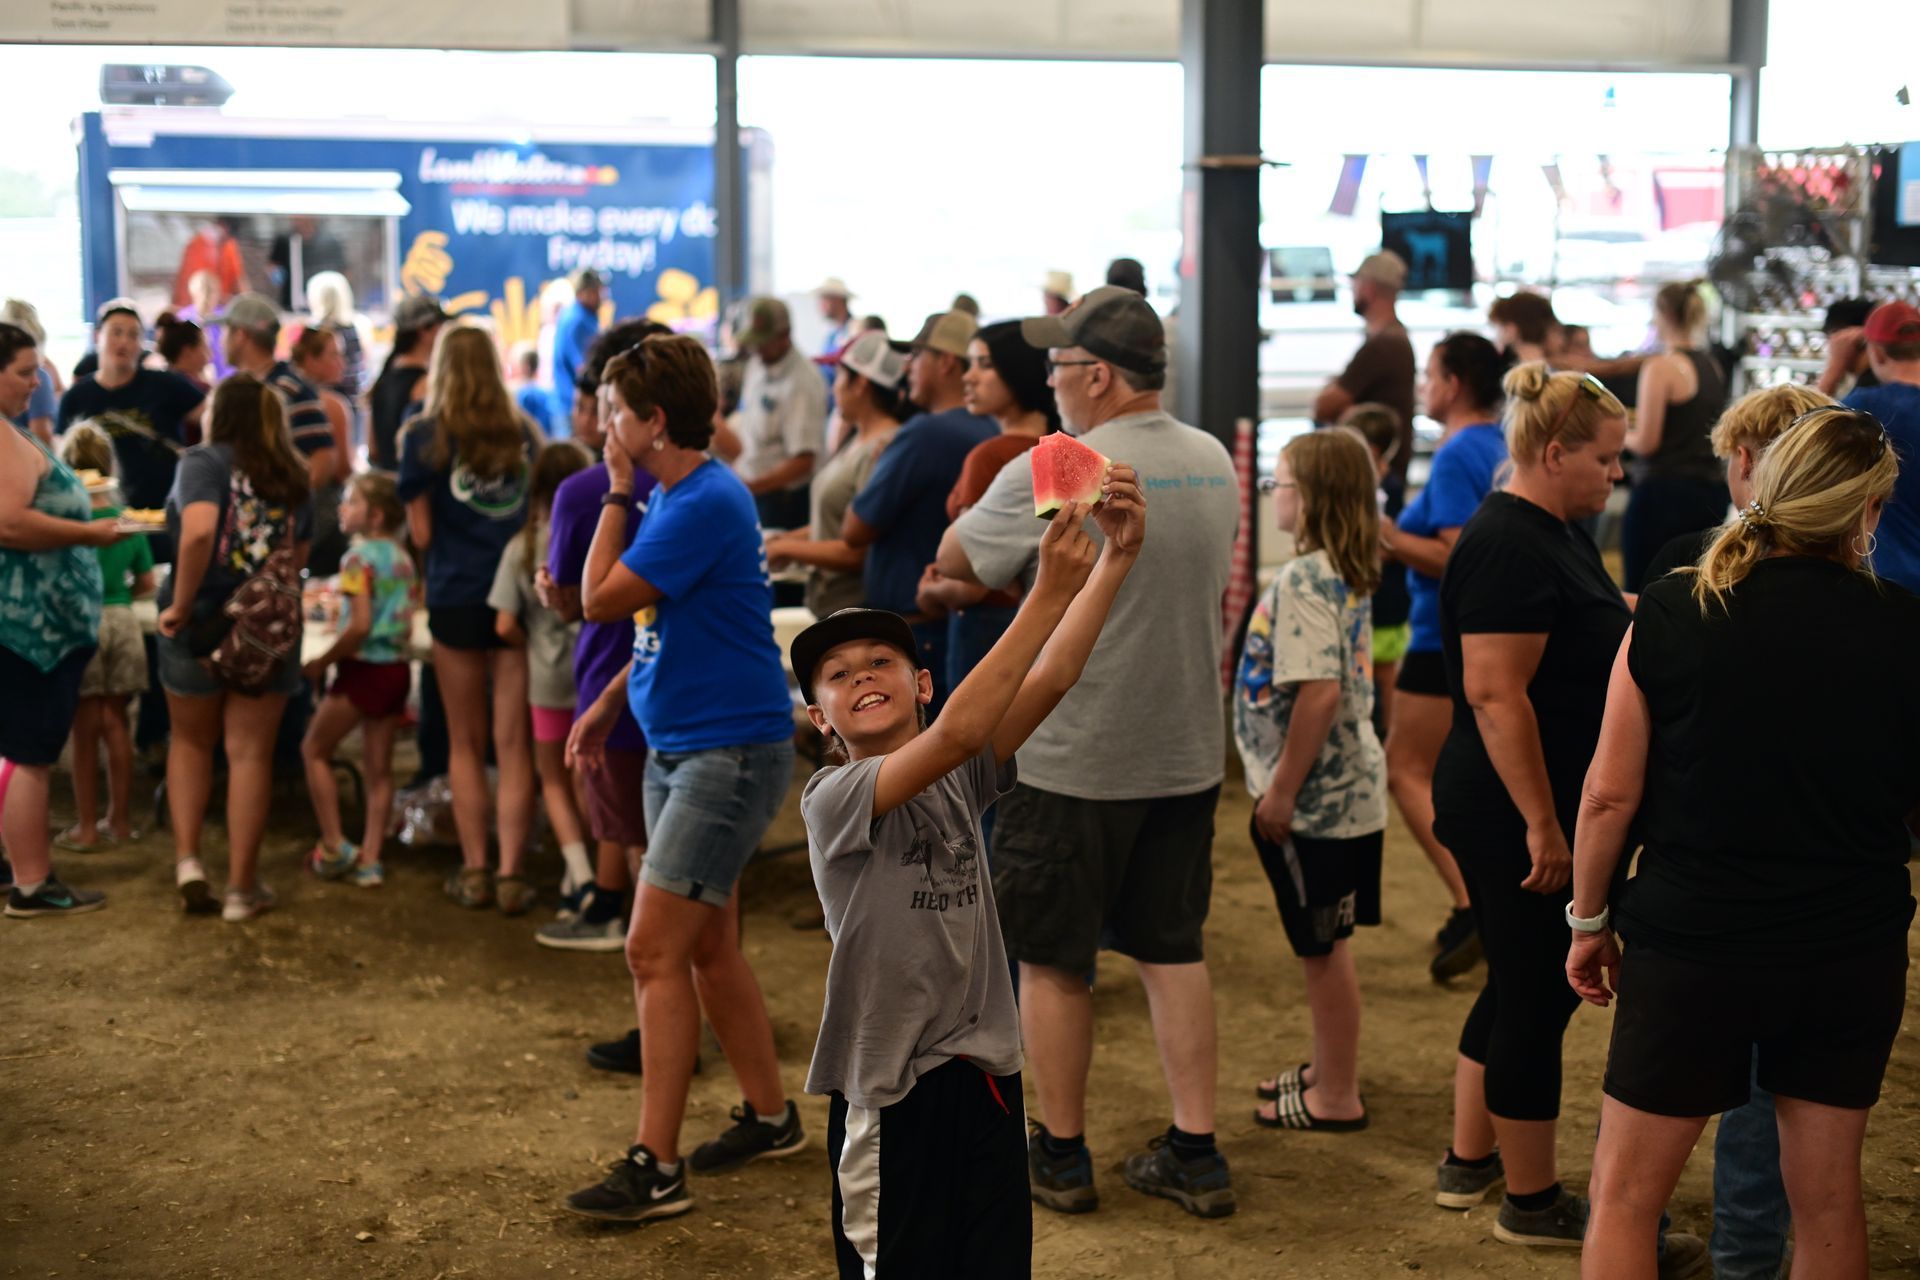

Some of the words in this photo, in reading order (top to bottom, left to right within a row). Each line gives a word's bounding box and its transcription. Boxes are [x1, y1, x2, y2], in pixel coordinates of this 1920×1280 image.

[451, 198, 505, 235] We
[507, 198, 595, 236] make
[597, 206, 678, 243] every
[546, 234, 656, 278] Fryday!
[1145, 477, 1181, 490] Here
[1185, 474, 1205, 486] for
[956, 884, 977, 908] TH
